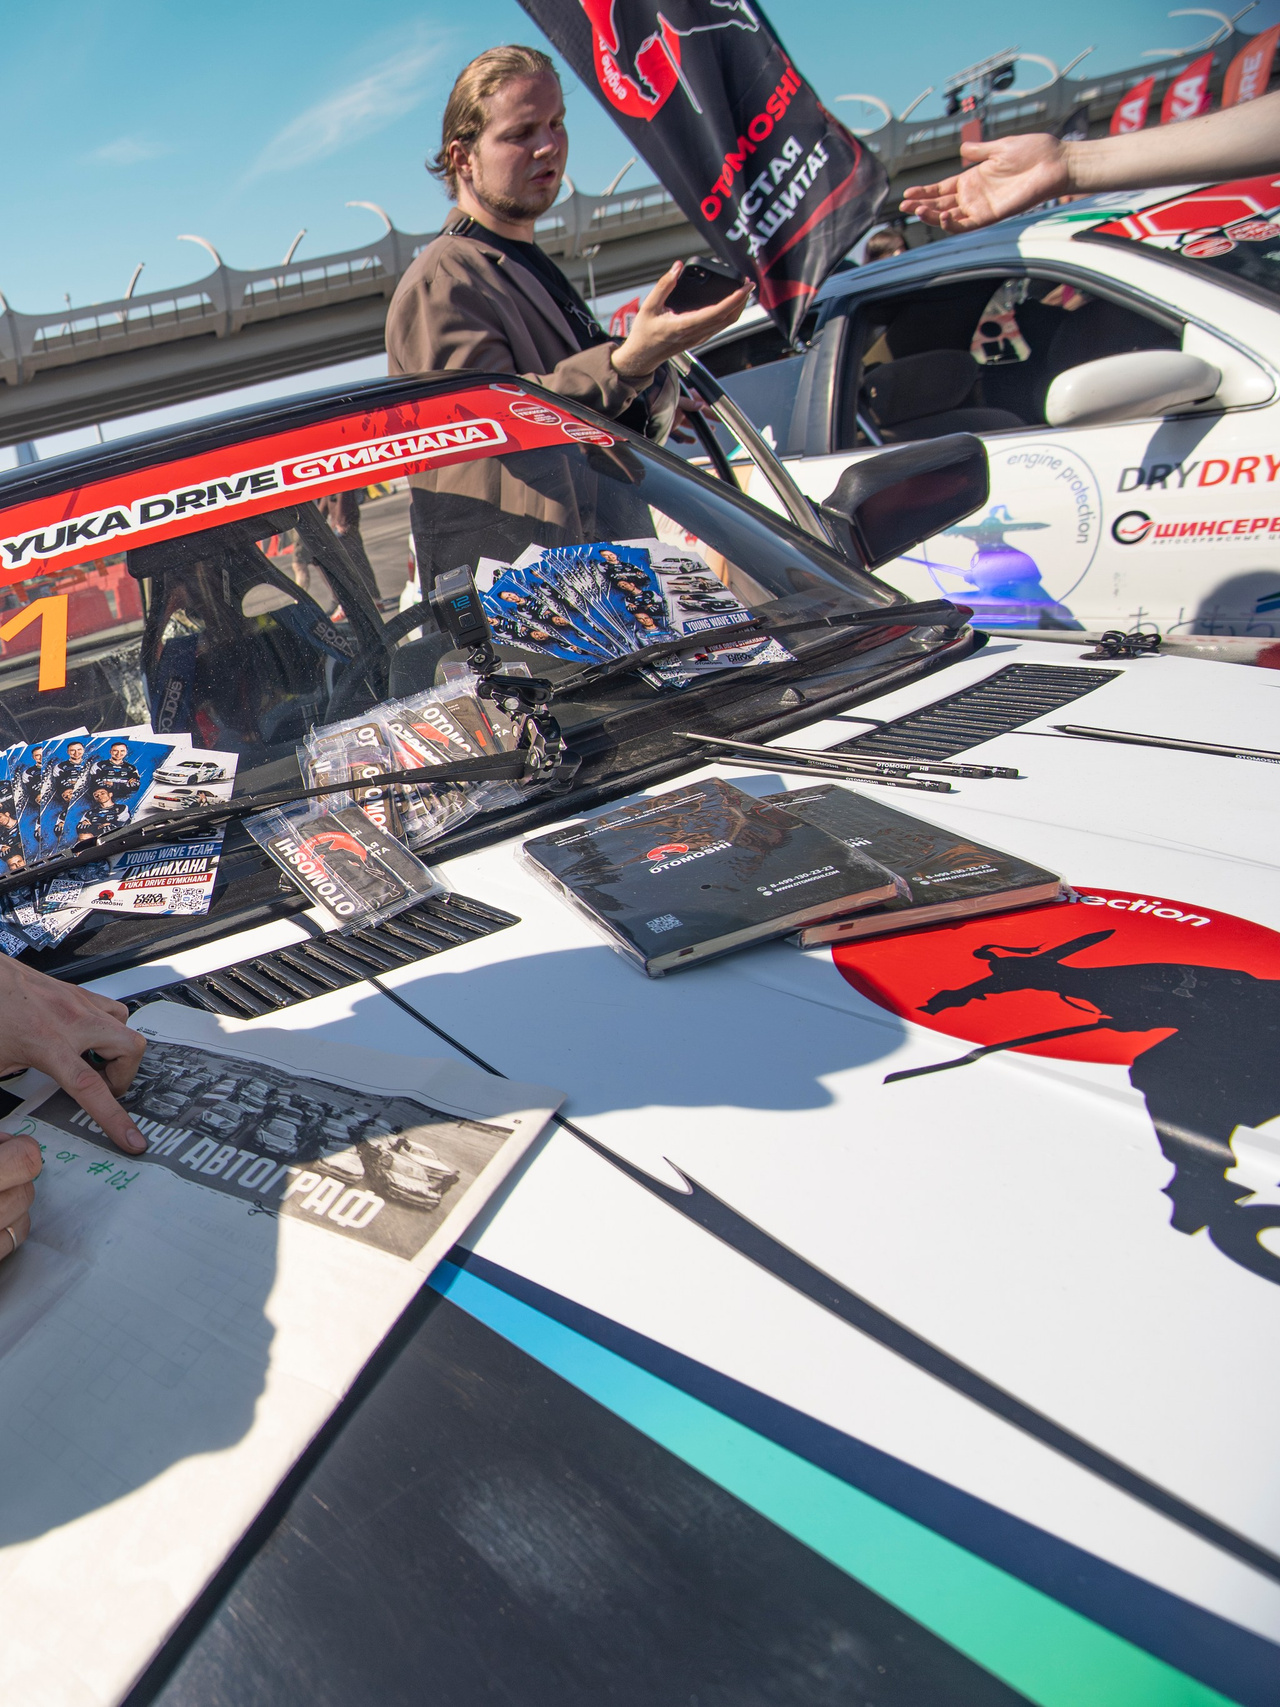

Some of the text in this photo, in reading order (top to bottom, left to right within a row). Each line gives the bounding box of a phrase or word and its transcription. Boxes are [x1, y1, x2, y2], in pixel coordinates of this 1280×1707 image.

[700, 67, 802, 222] OTOMOSHI
[746, 139, 829, 259] АЩИТА!
[2, 425, 488, 564] YUKA DRIVE GYMKHANA
[1007, 449, 1097, 544] engine protection
[450, 595, 471, 609] 12
[685, 612, 751, 632] YOUNG WAVE TEAM
[876, 762, 911, 770] OTOMOSHI
[125, 843, 215, 865] YOUNG WAVE TEAM
[649, 841, 733, 874] OTOMOSHI
[124, 874, 208, 889] YUKA DRIVE GYMKHANA
[126, 857, 208, 881] ДЖИМХАНА
[274, 837, 356, 916] OTOMOSHI
[770, 865, 834, 889] 8-499-130-23-23
[774, 869, 841, 894] WWW.OTOMOSHI.COM
[178, 1137, 385, 1229] АВТОГРАФ
